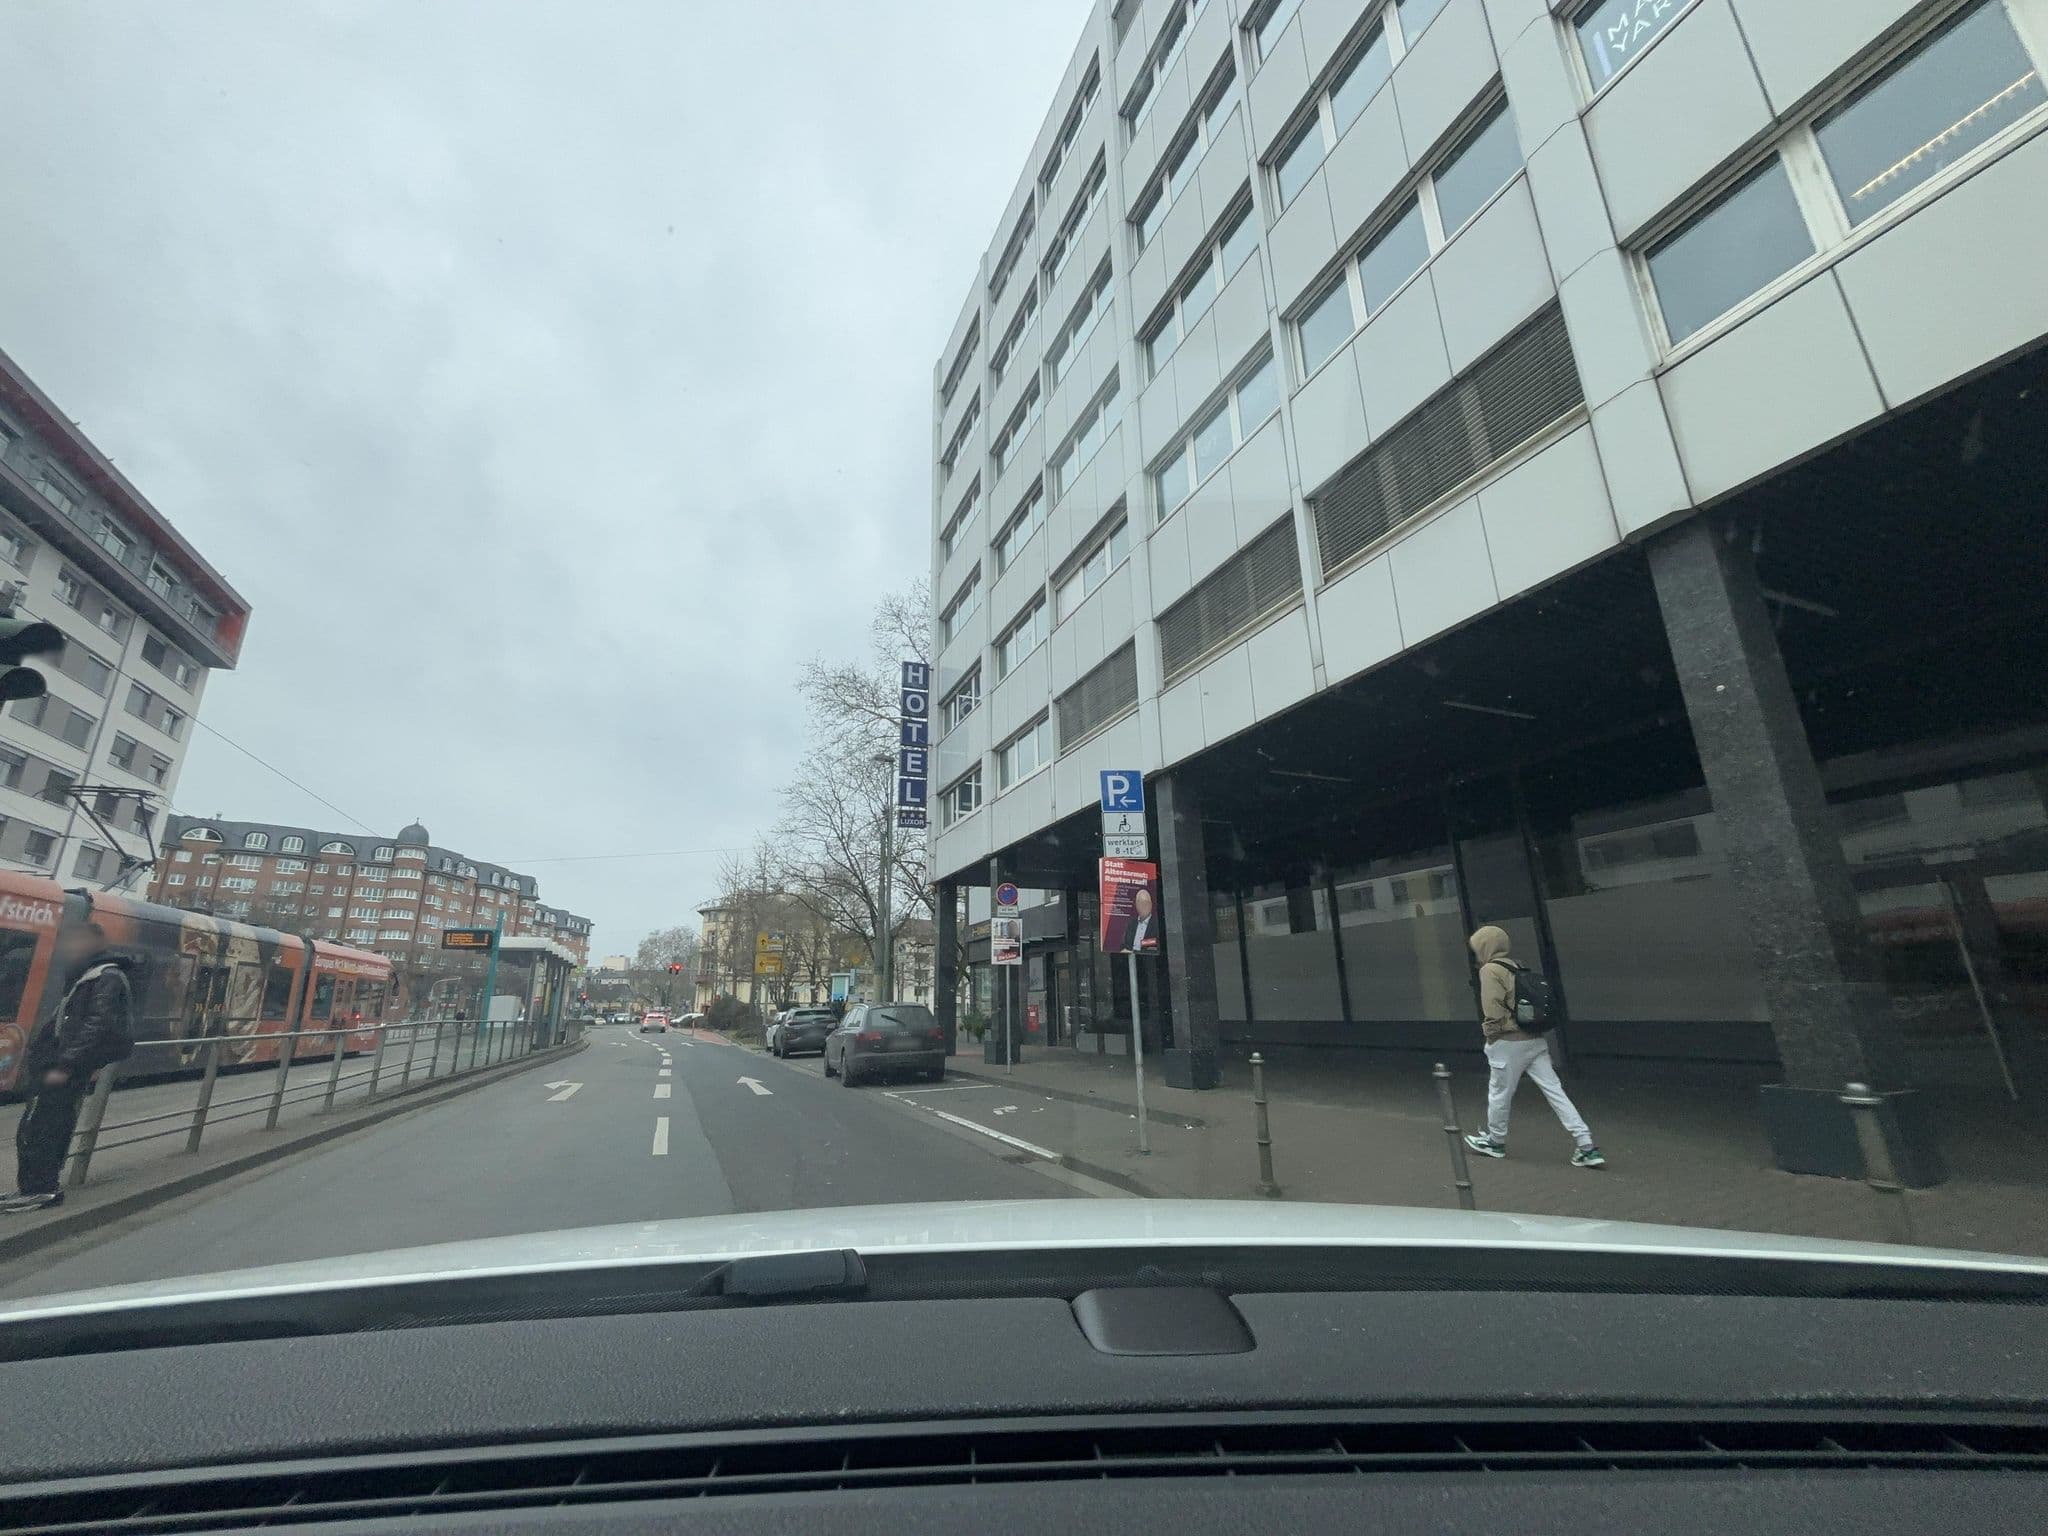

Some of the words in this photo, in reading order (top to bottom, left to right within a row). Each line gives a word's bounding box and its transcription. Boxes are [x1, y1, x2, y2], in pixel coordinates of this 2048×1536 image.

[905, 664, 925, 802] HOTEL
[1106, 775, 1130, 807] P
[900, 818, 925, 826] LUXOR
[1104, 860, 1124, 869] Statt
[1104, 875, 1131, 884] Renten
